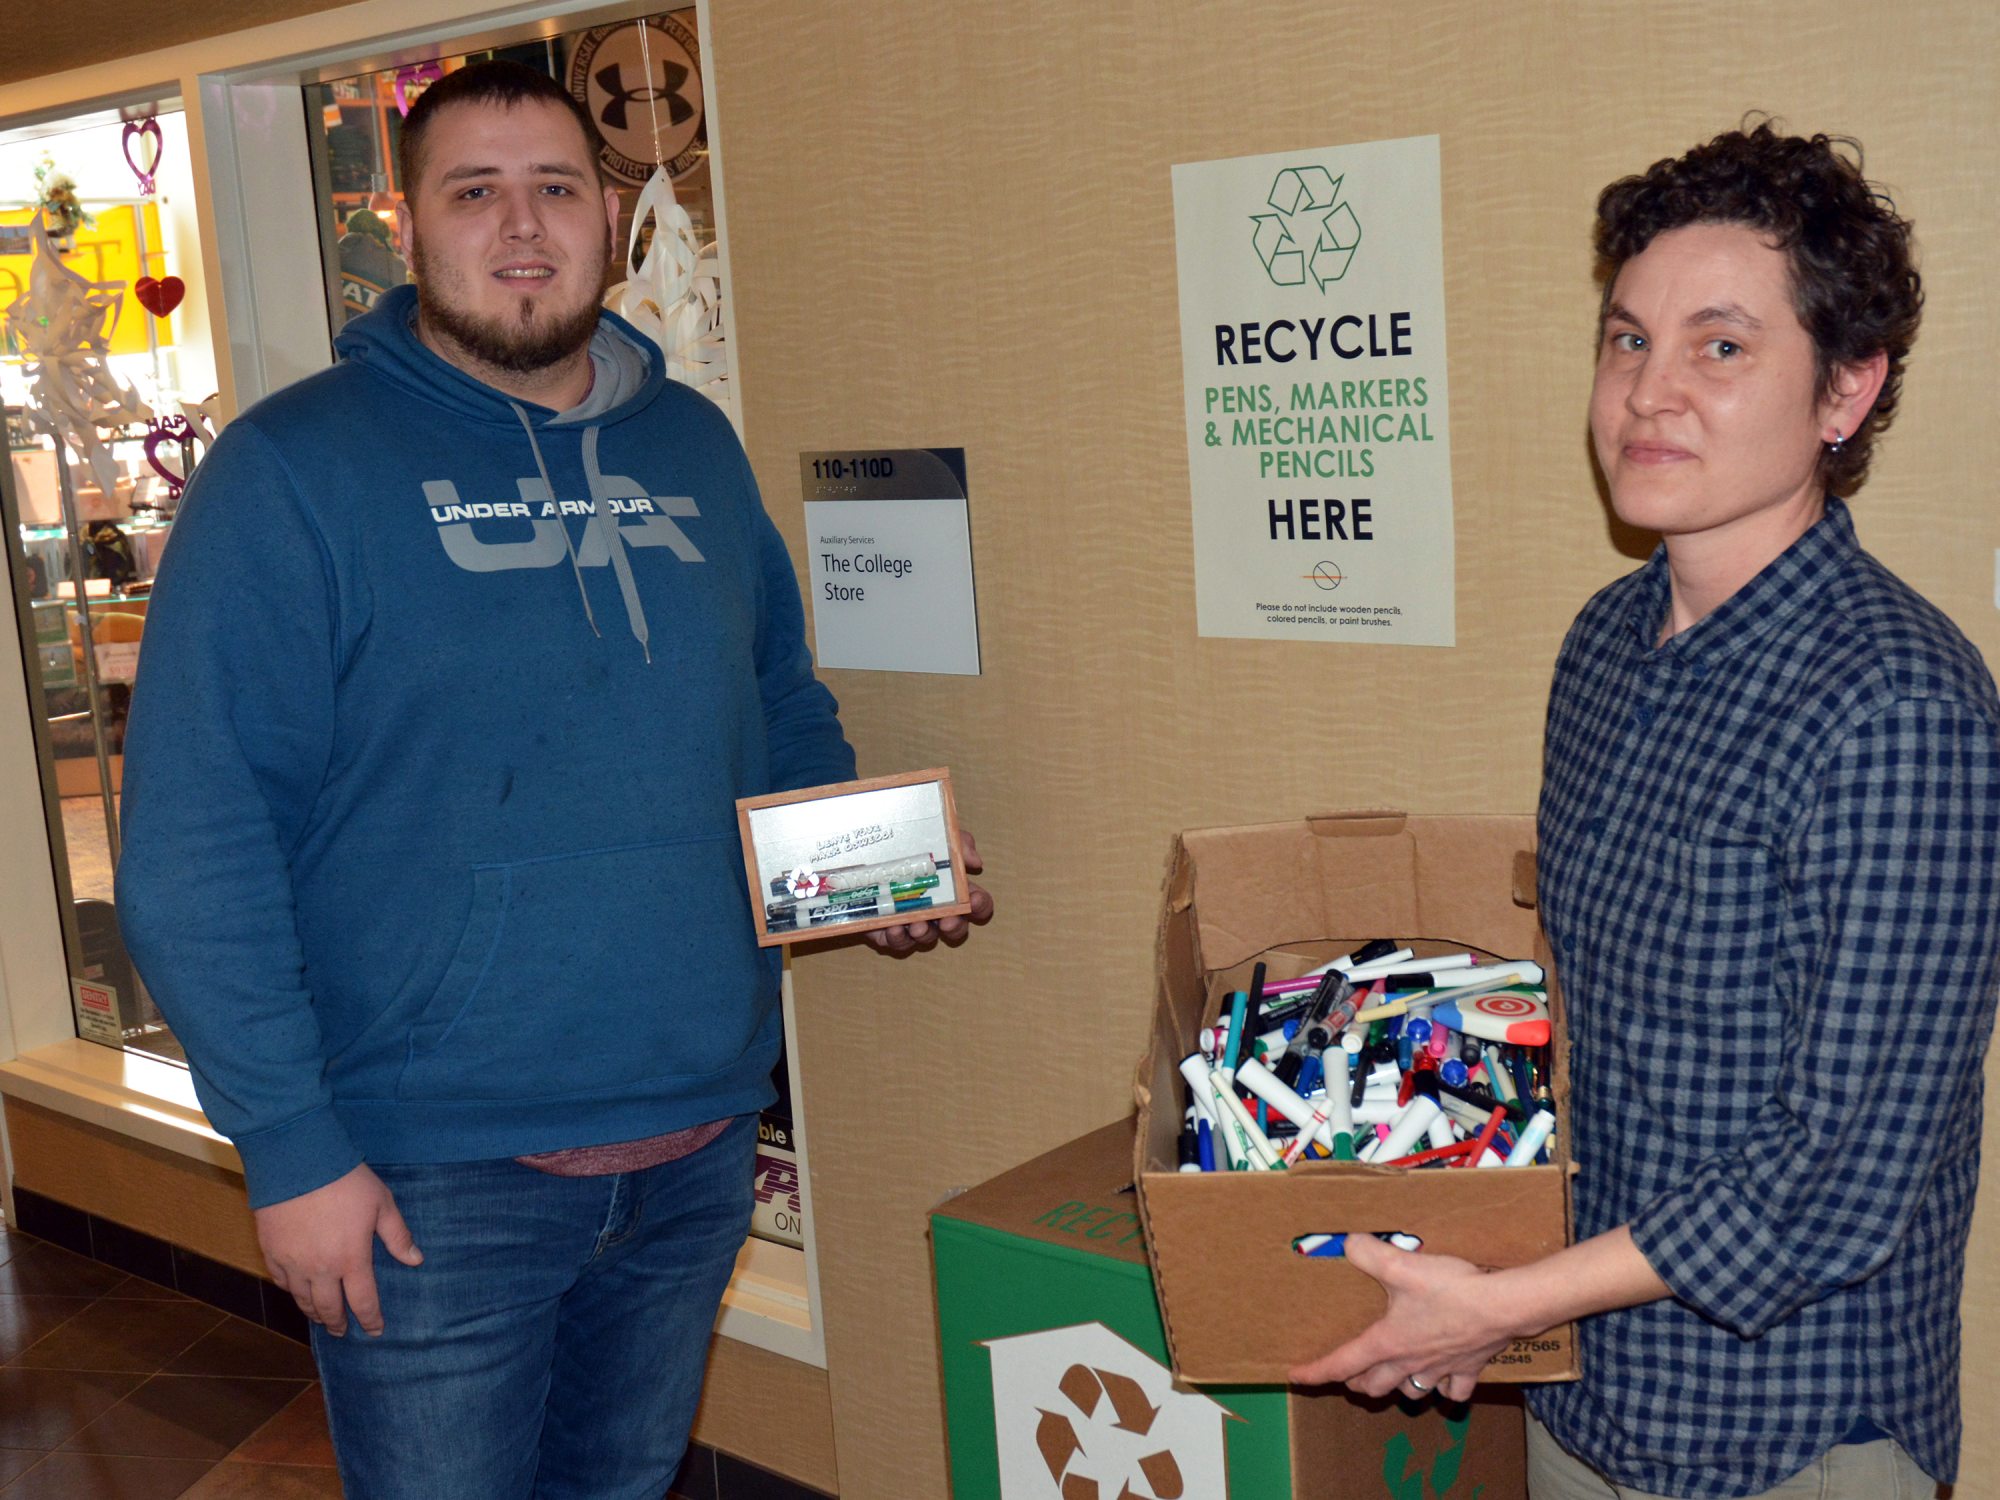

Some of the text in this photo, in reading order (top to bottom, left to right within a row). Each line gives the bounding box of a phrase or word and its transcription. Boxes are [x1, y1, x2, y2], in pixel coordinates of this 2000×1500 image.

[600, 143, 648, 179] PROTECT
[1215, 312, 1412, 365] RECYCLE
[1206, 377, 1429, 415] PENS, MARKERS
[1205, 413, 1433, 447] & MECHANICAL
[813, 457, 894, 480] 110-110D
[1260, 449, 1374, 478] PENCILS
[431, 499, 655, 522] UNDER ARMOUR
[1268, 499, 1373, 540] HERE
[820, 536, 875, 546] Auxiliary Services
[821, 554, 912, 578] The College
[824, 583, 864, 601] Store
[1256, 603, 1280, 611] Please
[1282, 604, 1292, 612] do
[1294, 604, 1307, 612] not
[1309, 604, 1337, 613] include
[1340, 606, 1372, 614] wooden
[1267, 615, 1296, 623] colored
[1339, 617, 1360, 625] paint
[1361, 617, 1393, 627] brushes.
[1512, 1341, 1560, 1353] 27565
